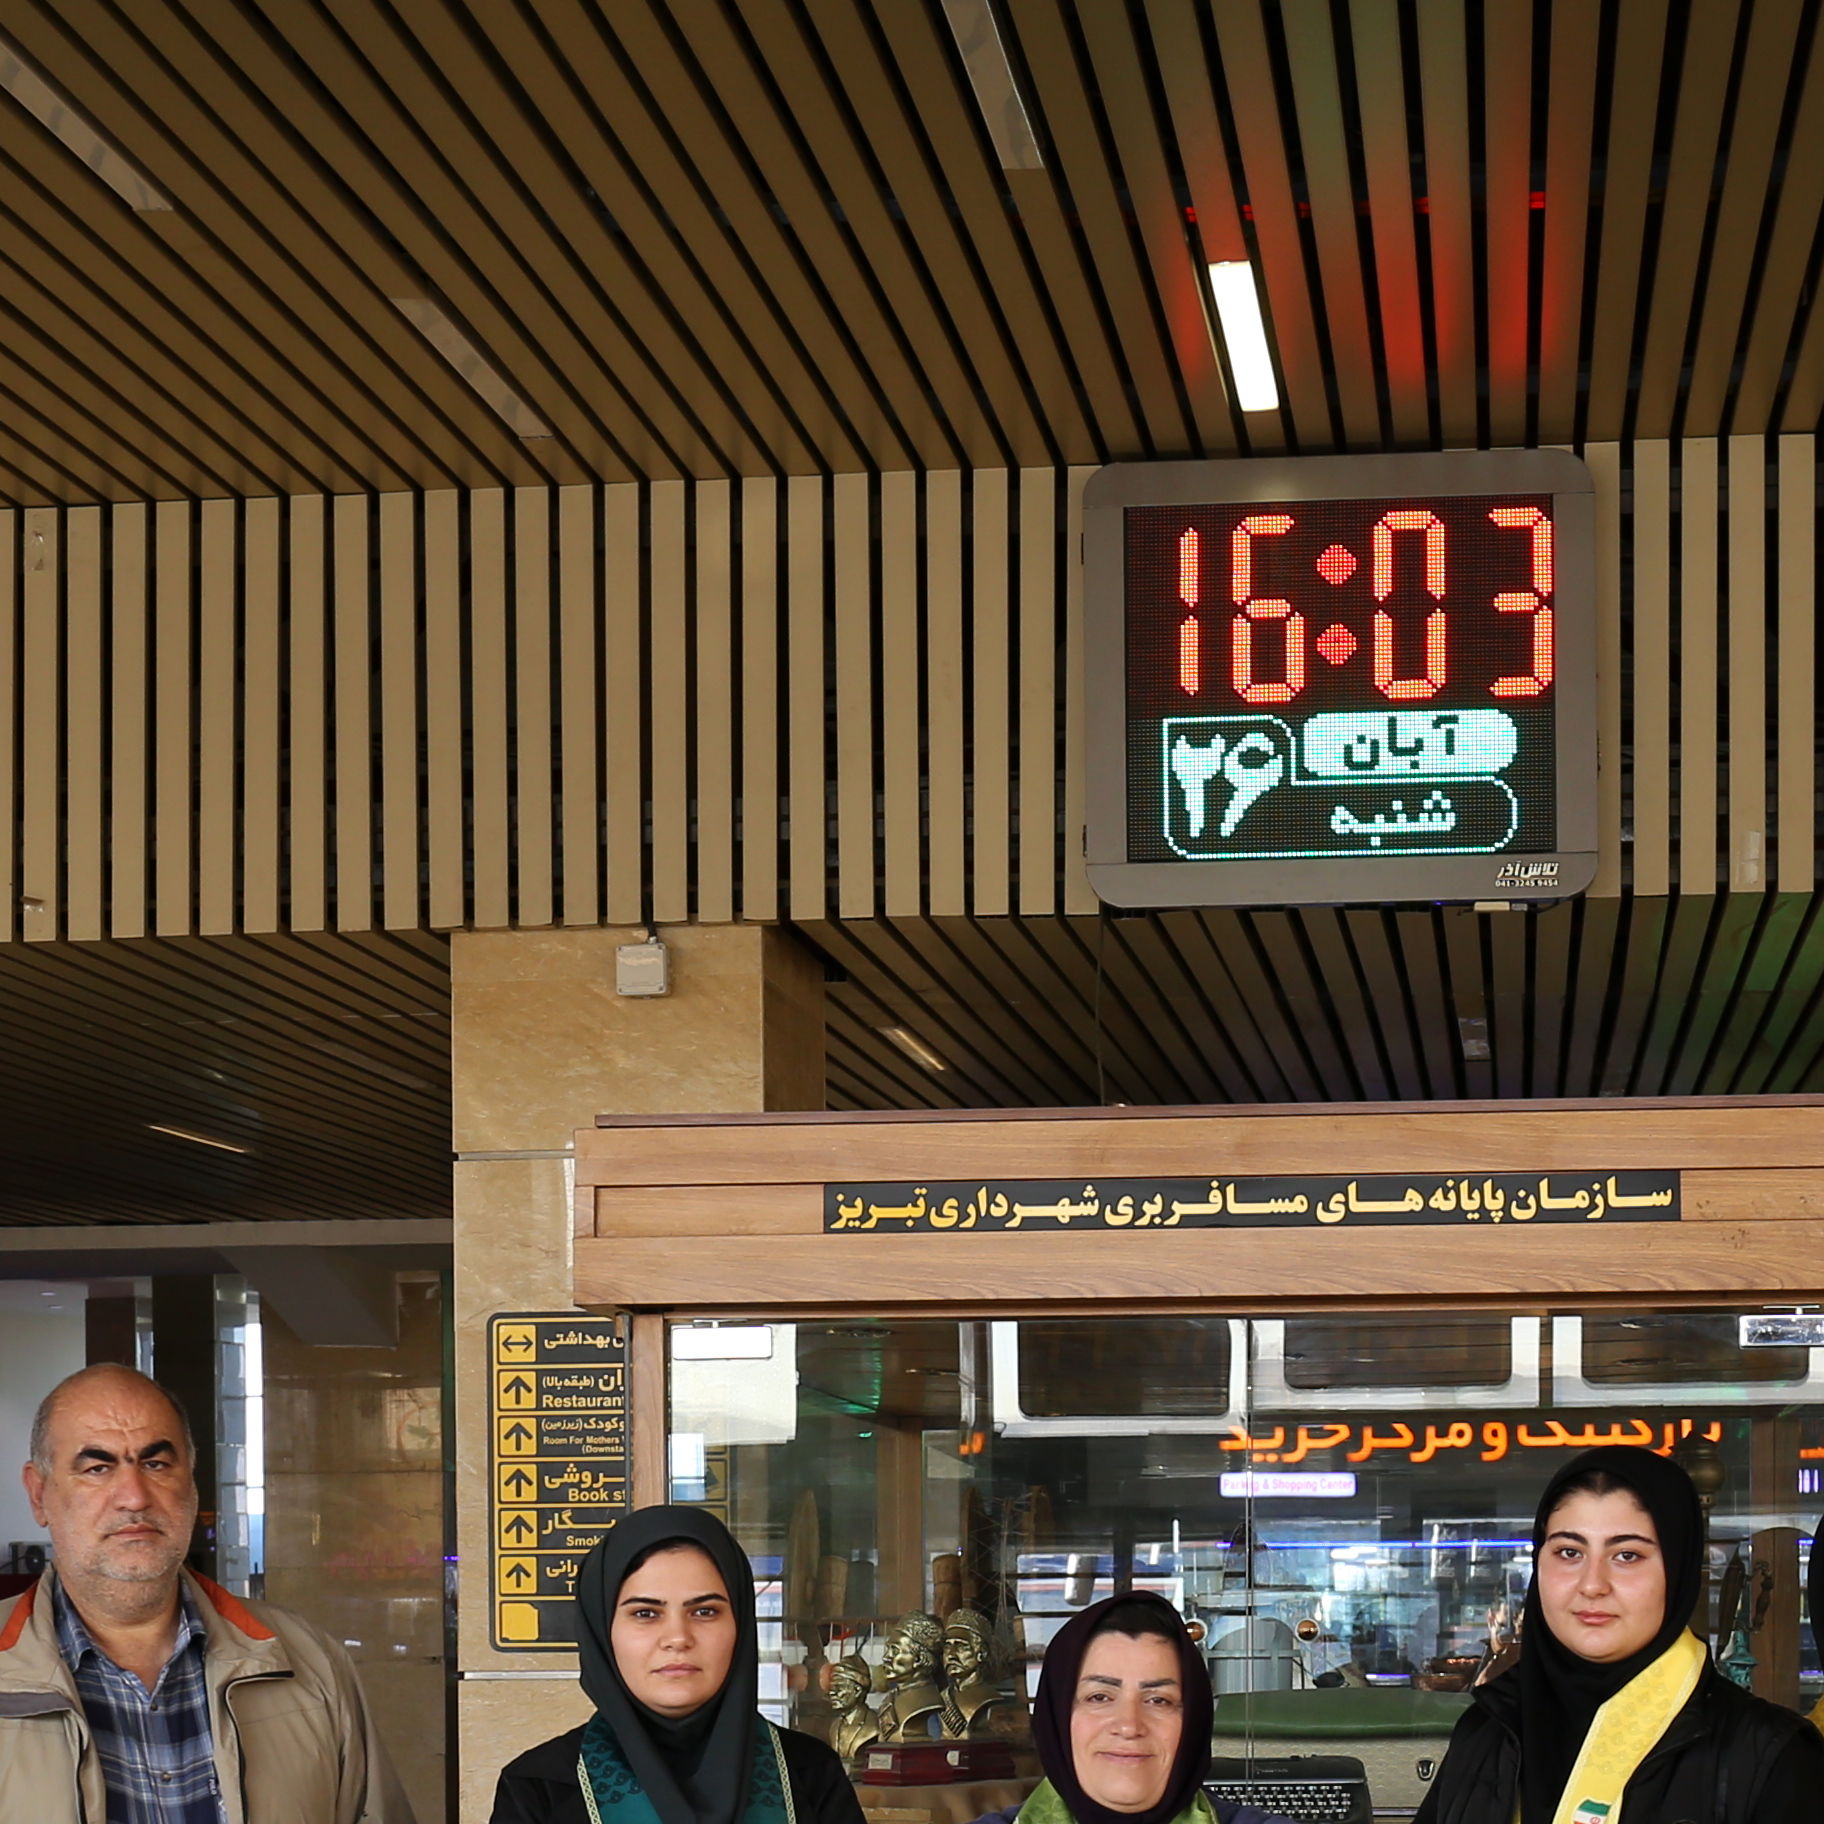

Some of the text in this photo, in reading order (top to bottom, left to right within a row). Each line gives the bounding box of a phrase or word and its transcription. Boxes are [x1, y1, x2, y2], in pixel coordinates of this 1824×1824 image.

[1180, 507, 1553, 702] 16:03
[1344, 714, 1459, 772] آبان
[1331, 791, 1455, 846] شنبه
[830, 1187, 927, 1230] تبریز
[929, 1184, 1099, 1230] شهرداری
[1316, 1181, 1424, 1223] های
[1429, 1178, 1505, 1223] پایانه
[1511, 1176, 1673, 1221] سازمان
[544, 1330, 610, 1349] بهداشتی
[543, 1435, 619, 1445] Room For Mothers
[584, 1417, 618, 1432] کودک
[568, 1487, 609, 1501] Book
